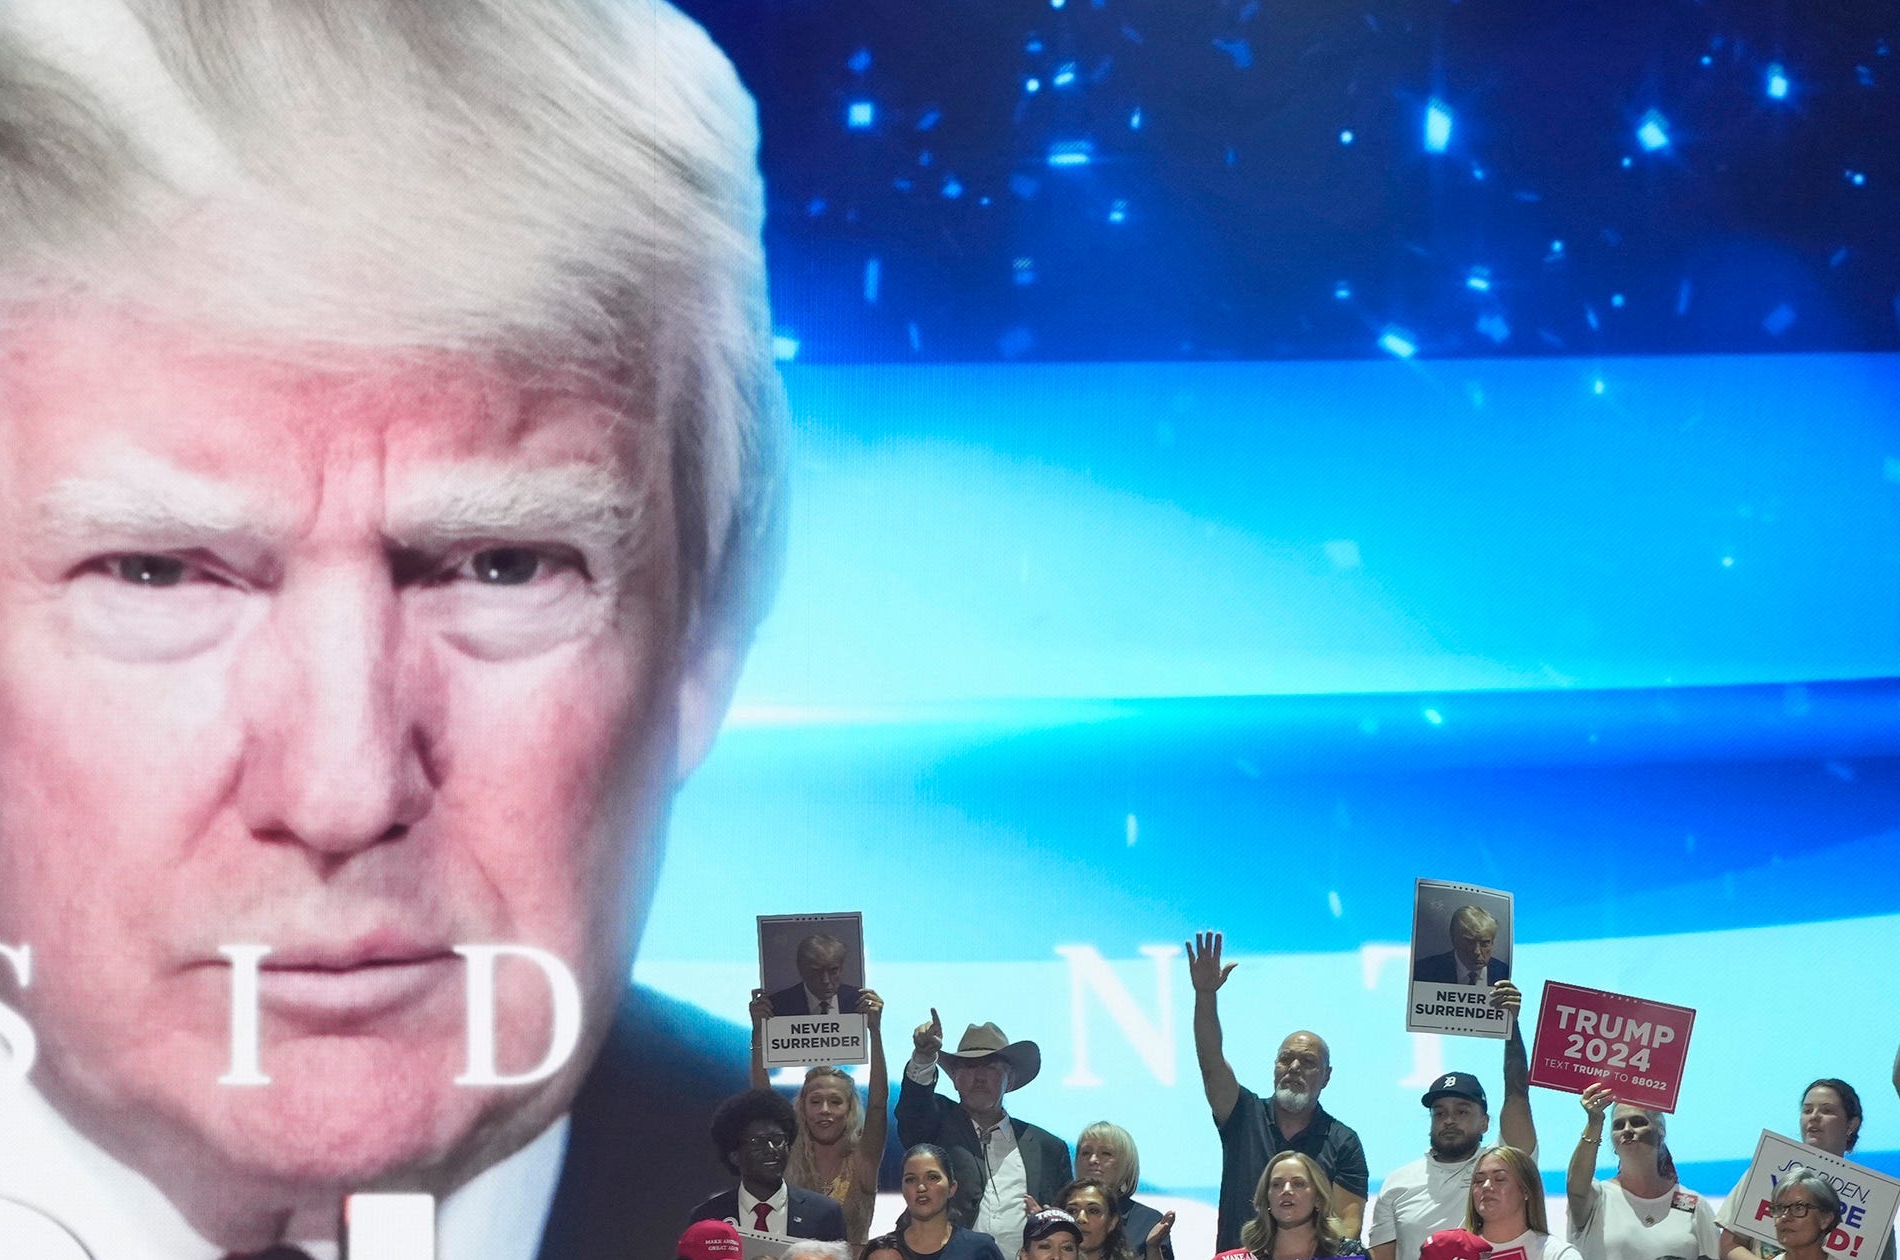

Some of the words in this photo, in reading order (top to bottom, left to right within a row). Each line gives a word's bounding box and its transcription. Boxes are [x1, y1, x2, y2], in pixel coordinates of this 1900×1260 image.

[1436, 990, 1486, 1005] NEVER
[1415, 1004, 1504, 1021] SURRENDER
[791, 1022, 840, 1036] NEVER
[1555, 1004, 1675, 1048] TRUMP
[771, 1035, 860, 1050] SURRENDER
[1564, 1035, 1650, 1072] 2024
[1543, 1057, 1570, 1071] TEXT
[1572, 1063, 1611, 1078] TRUMP
[1614, 1071, 1628, 1083] TO
[1631, 1076, 1667, 1091] 88022
